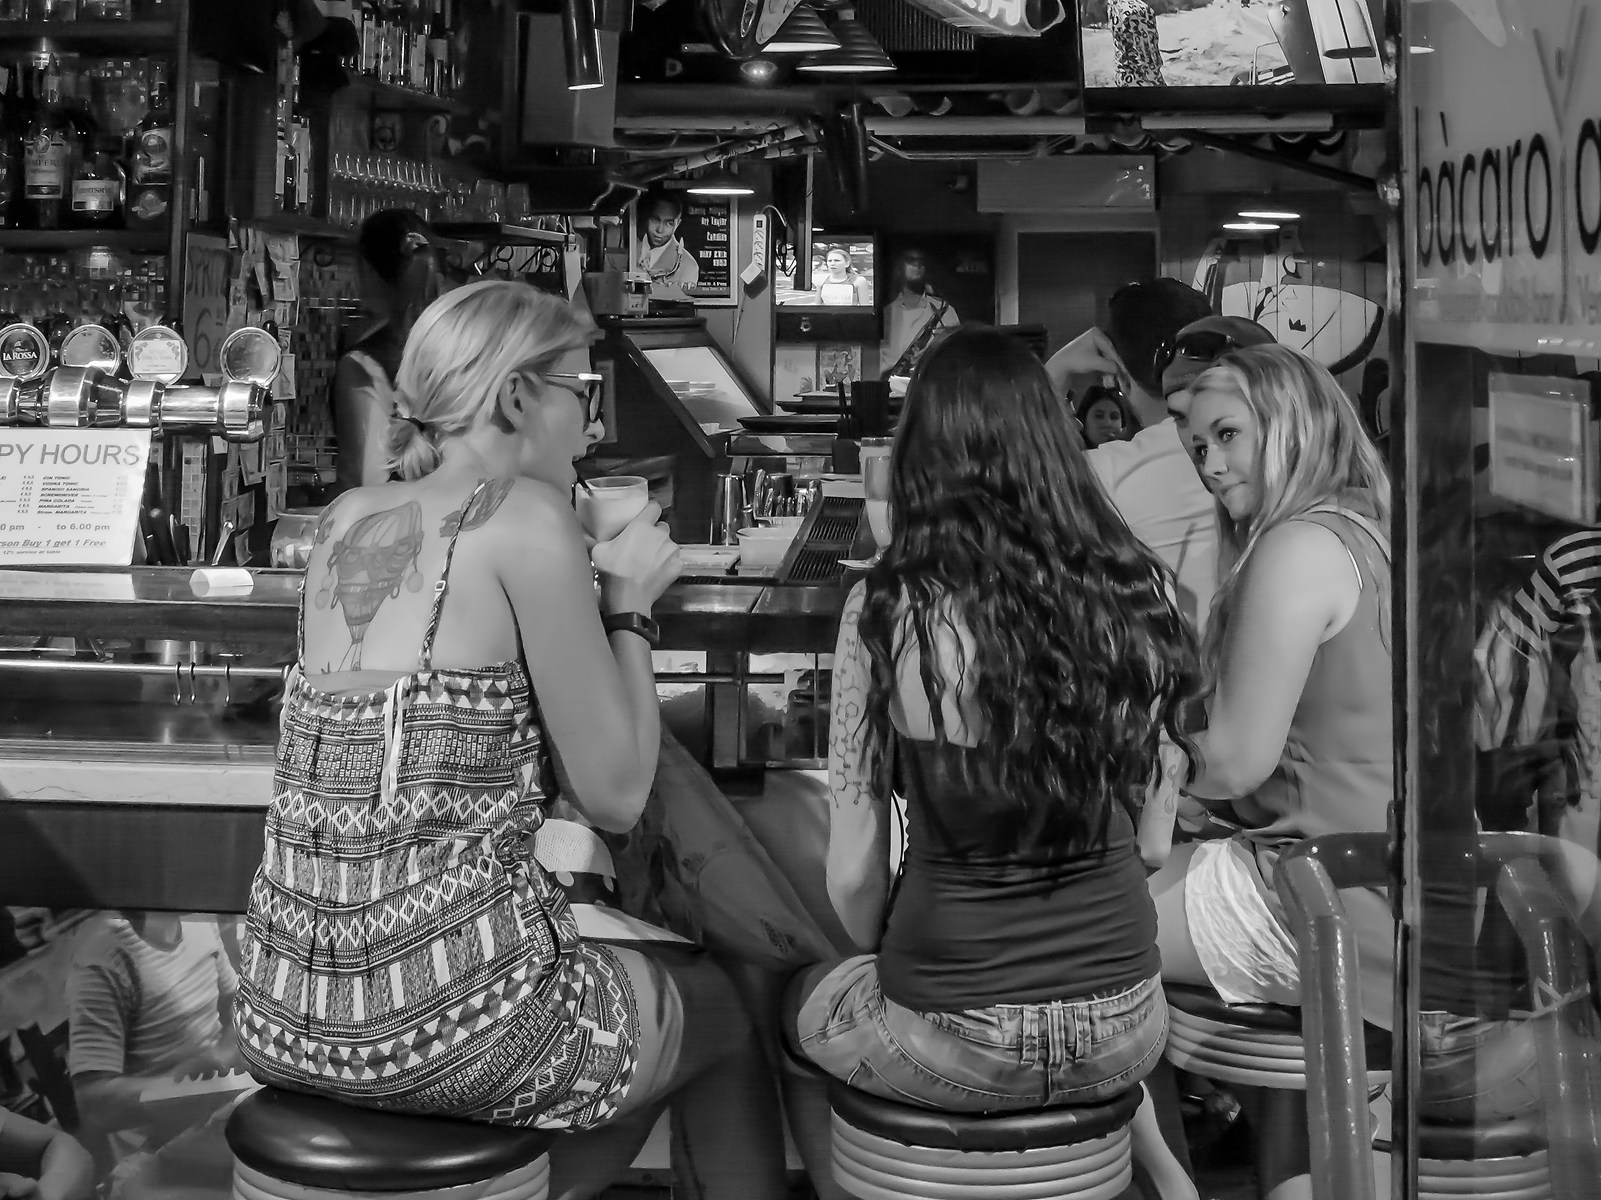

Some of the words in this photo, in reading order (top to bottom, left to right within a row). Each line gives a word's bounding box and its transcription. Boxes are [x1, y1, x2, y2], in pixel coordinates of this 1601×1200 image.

[3, 352, 12, 361] LA
[12, 351, 38, 360] ROSSA
[39, 443, 141, 466] HOURS
[56, 523, 67, 531] to
[69, 523, 92, 531] 6.00
[22, 540, 42, 548] Buy
